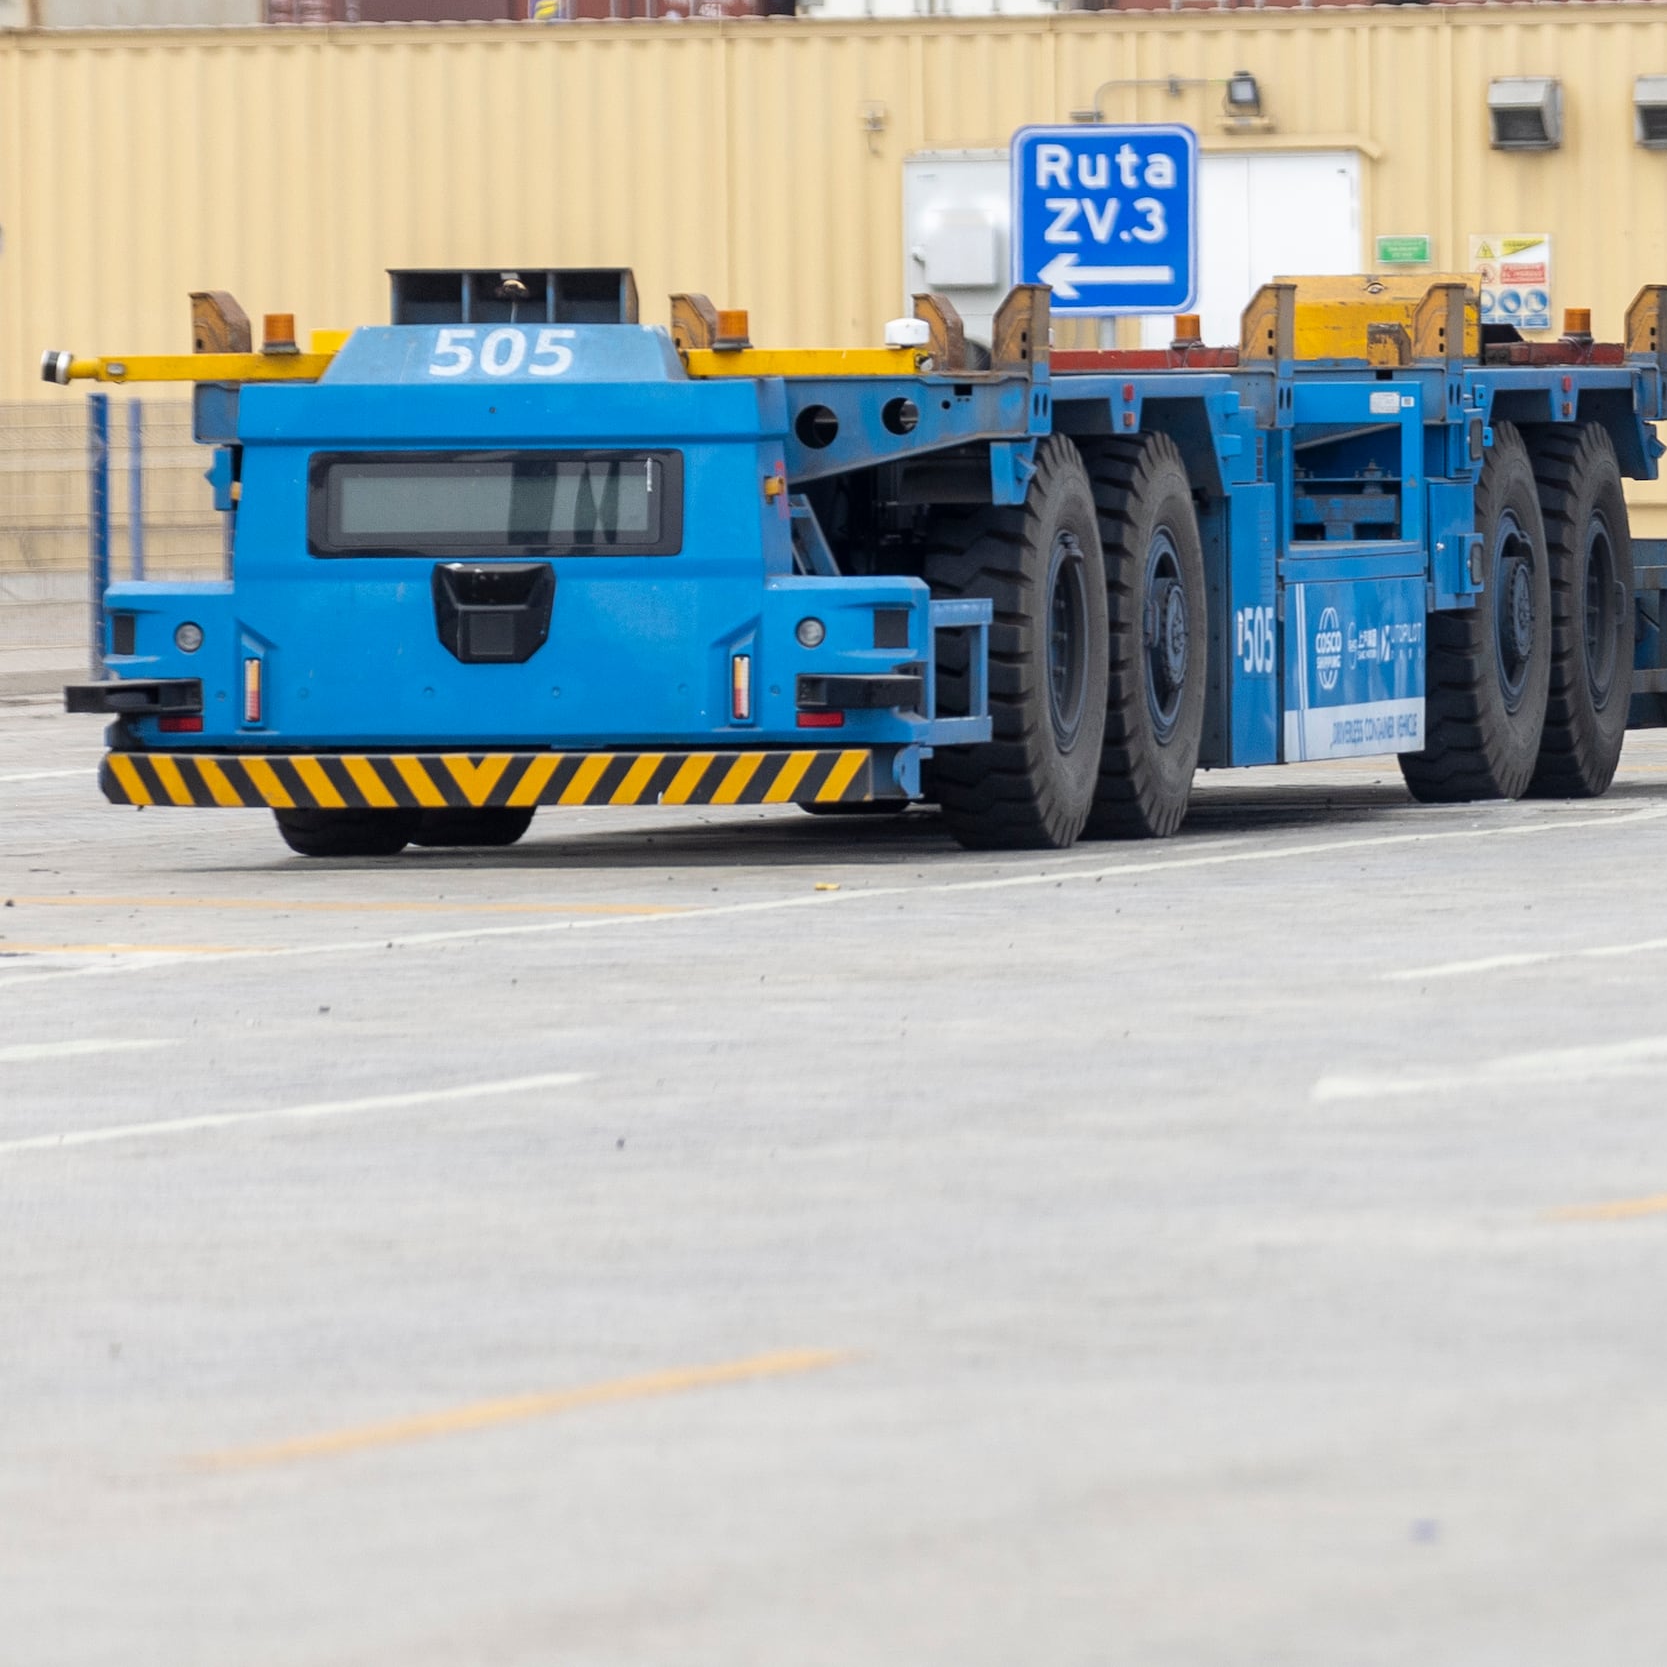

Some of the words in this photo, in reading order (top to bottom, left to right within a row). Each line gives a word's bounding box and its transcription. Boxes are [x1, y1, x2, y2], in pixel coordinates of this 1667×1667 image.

[1035, 142, 1176, 189] Ruta
[1043, 197, 1168, 245] ZV.3
[428, 328, 577, 377] 505
[1243, 605, 1274, 674] 505
[1315, 631, 1342, 654] COSCO
[1316, 654, 1342, 670] SHIPPING
